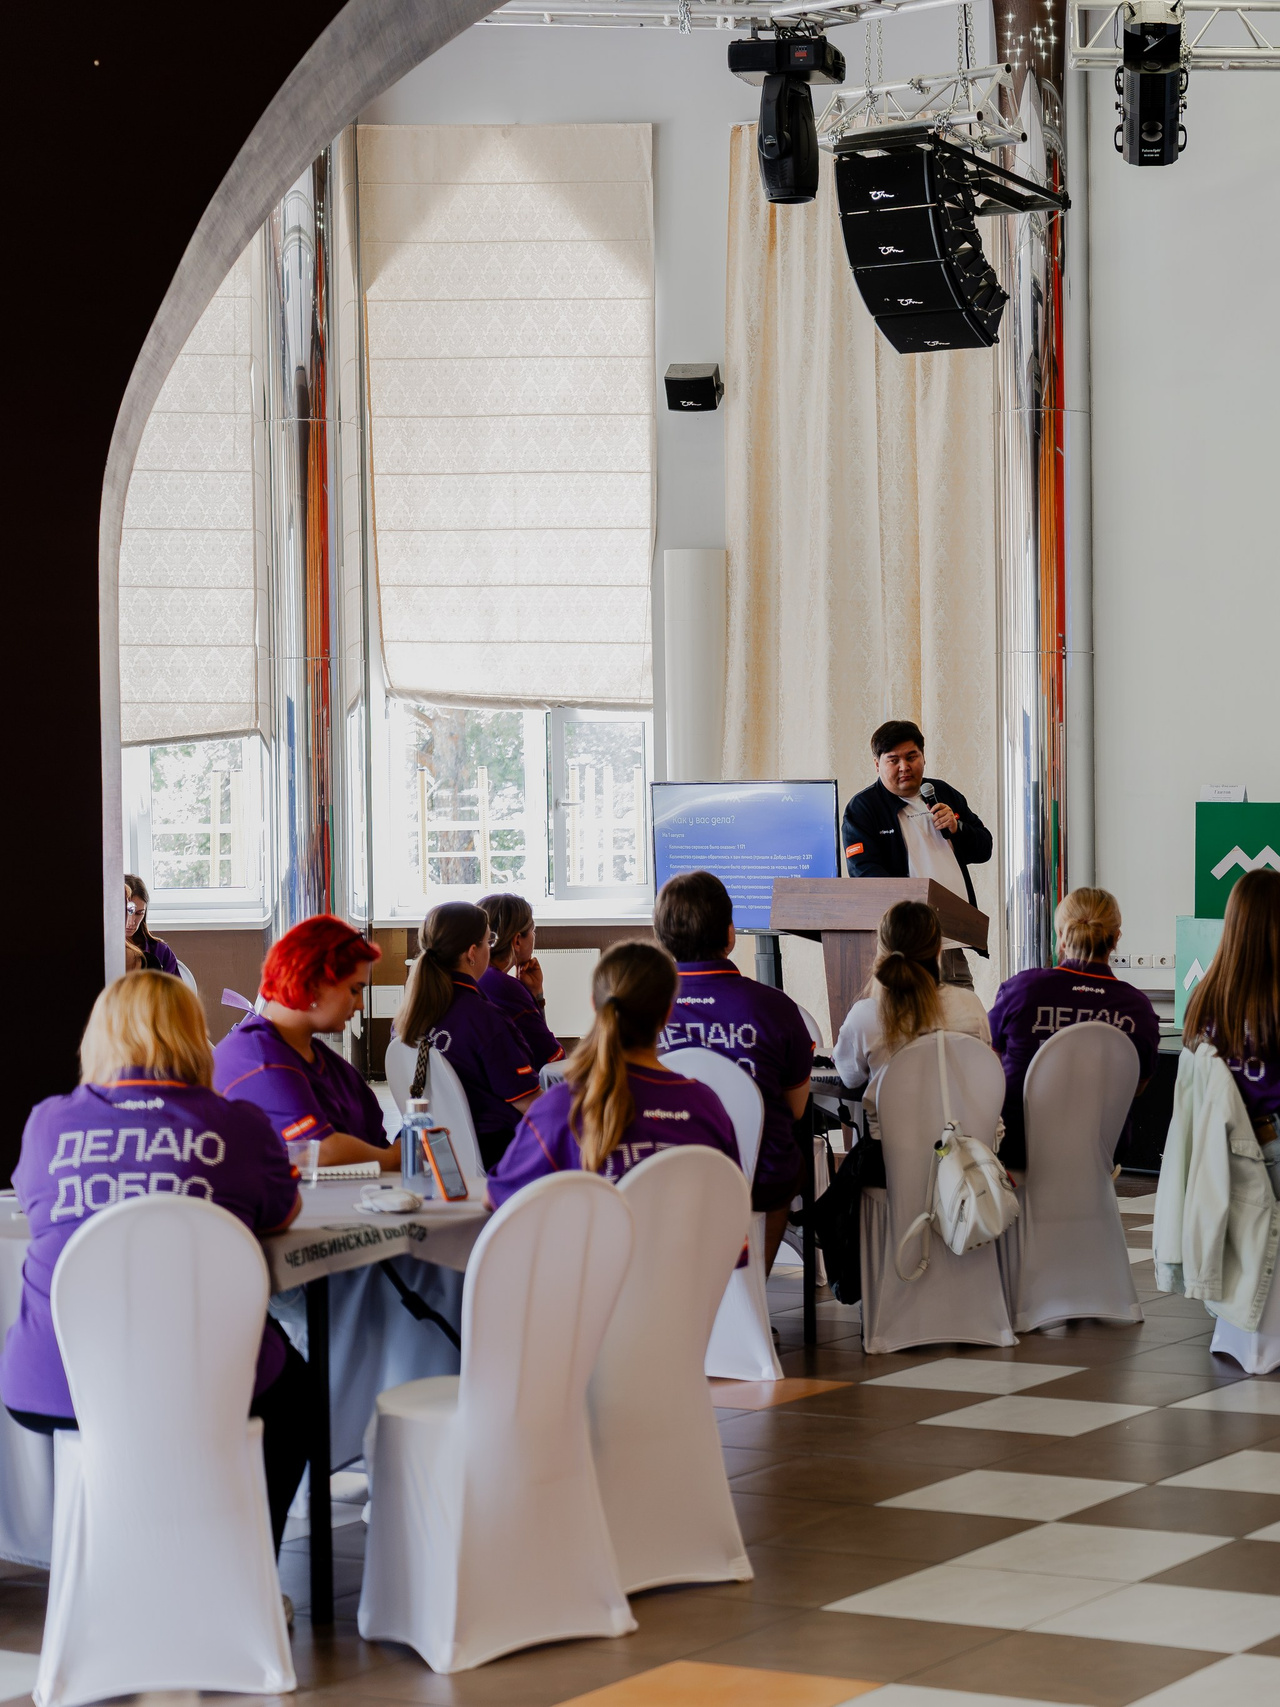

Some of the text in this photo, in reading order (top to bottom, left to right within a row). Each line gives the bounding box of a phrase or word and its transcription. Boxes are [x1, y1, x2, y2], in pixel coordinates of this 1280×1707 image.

[711, 815, 735, 826] дела?
[1072, 985, 1105, 994] добро.рф
[676, 996, 715, 1005] добро.рф
[643, 1108, 690, 1121] добро.рф
[48, 1127, 226, 1175] ДЕЛАЮ
[285, 1227, 382, 1268] ЧЕЛЯБИНСКАЯ
